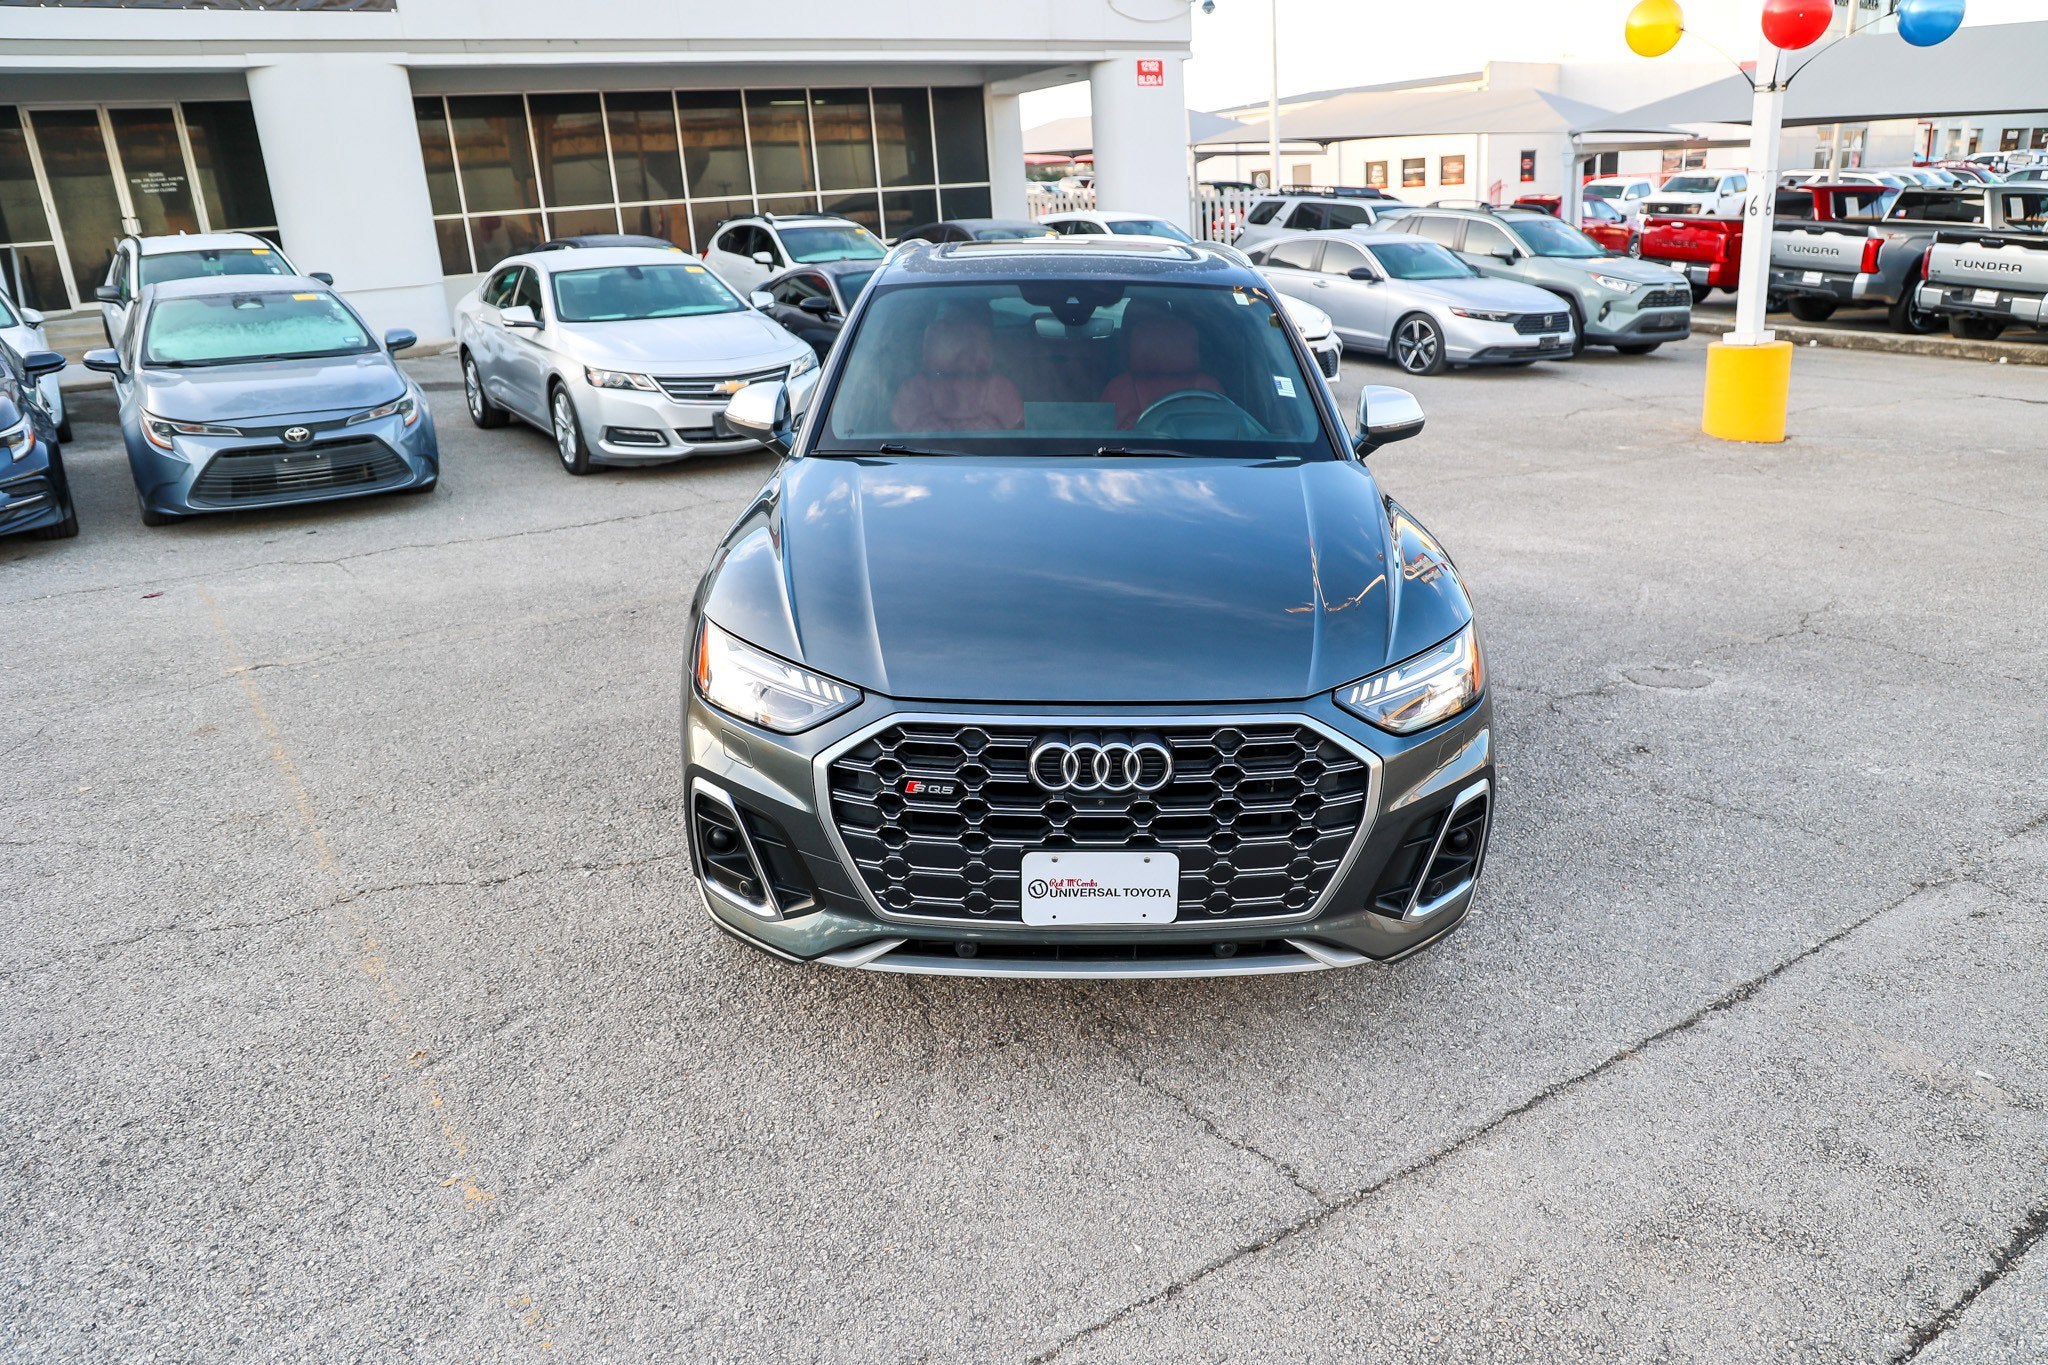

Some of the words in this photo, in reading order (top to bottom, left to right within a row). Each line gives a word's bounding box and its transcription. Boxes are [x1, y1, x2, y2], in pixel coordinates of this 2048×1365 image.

[1750, 195, 1758, 216] 6
[1765, 193, 1772, 216] 6
[1785, 244, 1840, 256] TUNDRA
[1953, 258, 2023, 273] TUNDRA
[911, 782, 954, 794] SQ5
[1049, 878, 1064, 890] Red
[1065, 878, 1098, 888] McCombs
[1049, 888, 1121, 898] UNIVERSAL
[1123, 888, 1171, 898] TOYOTA
